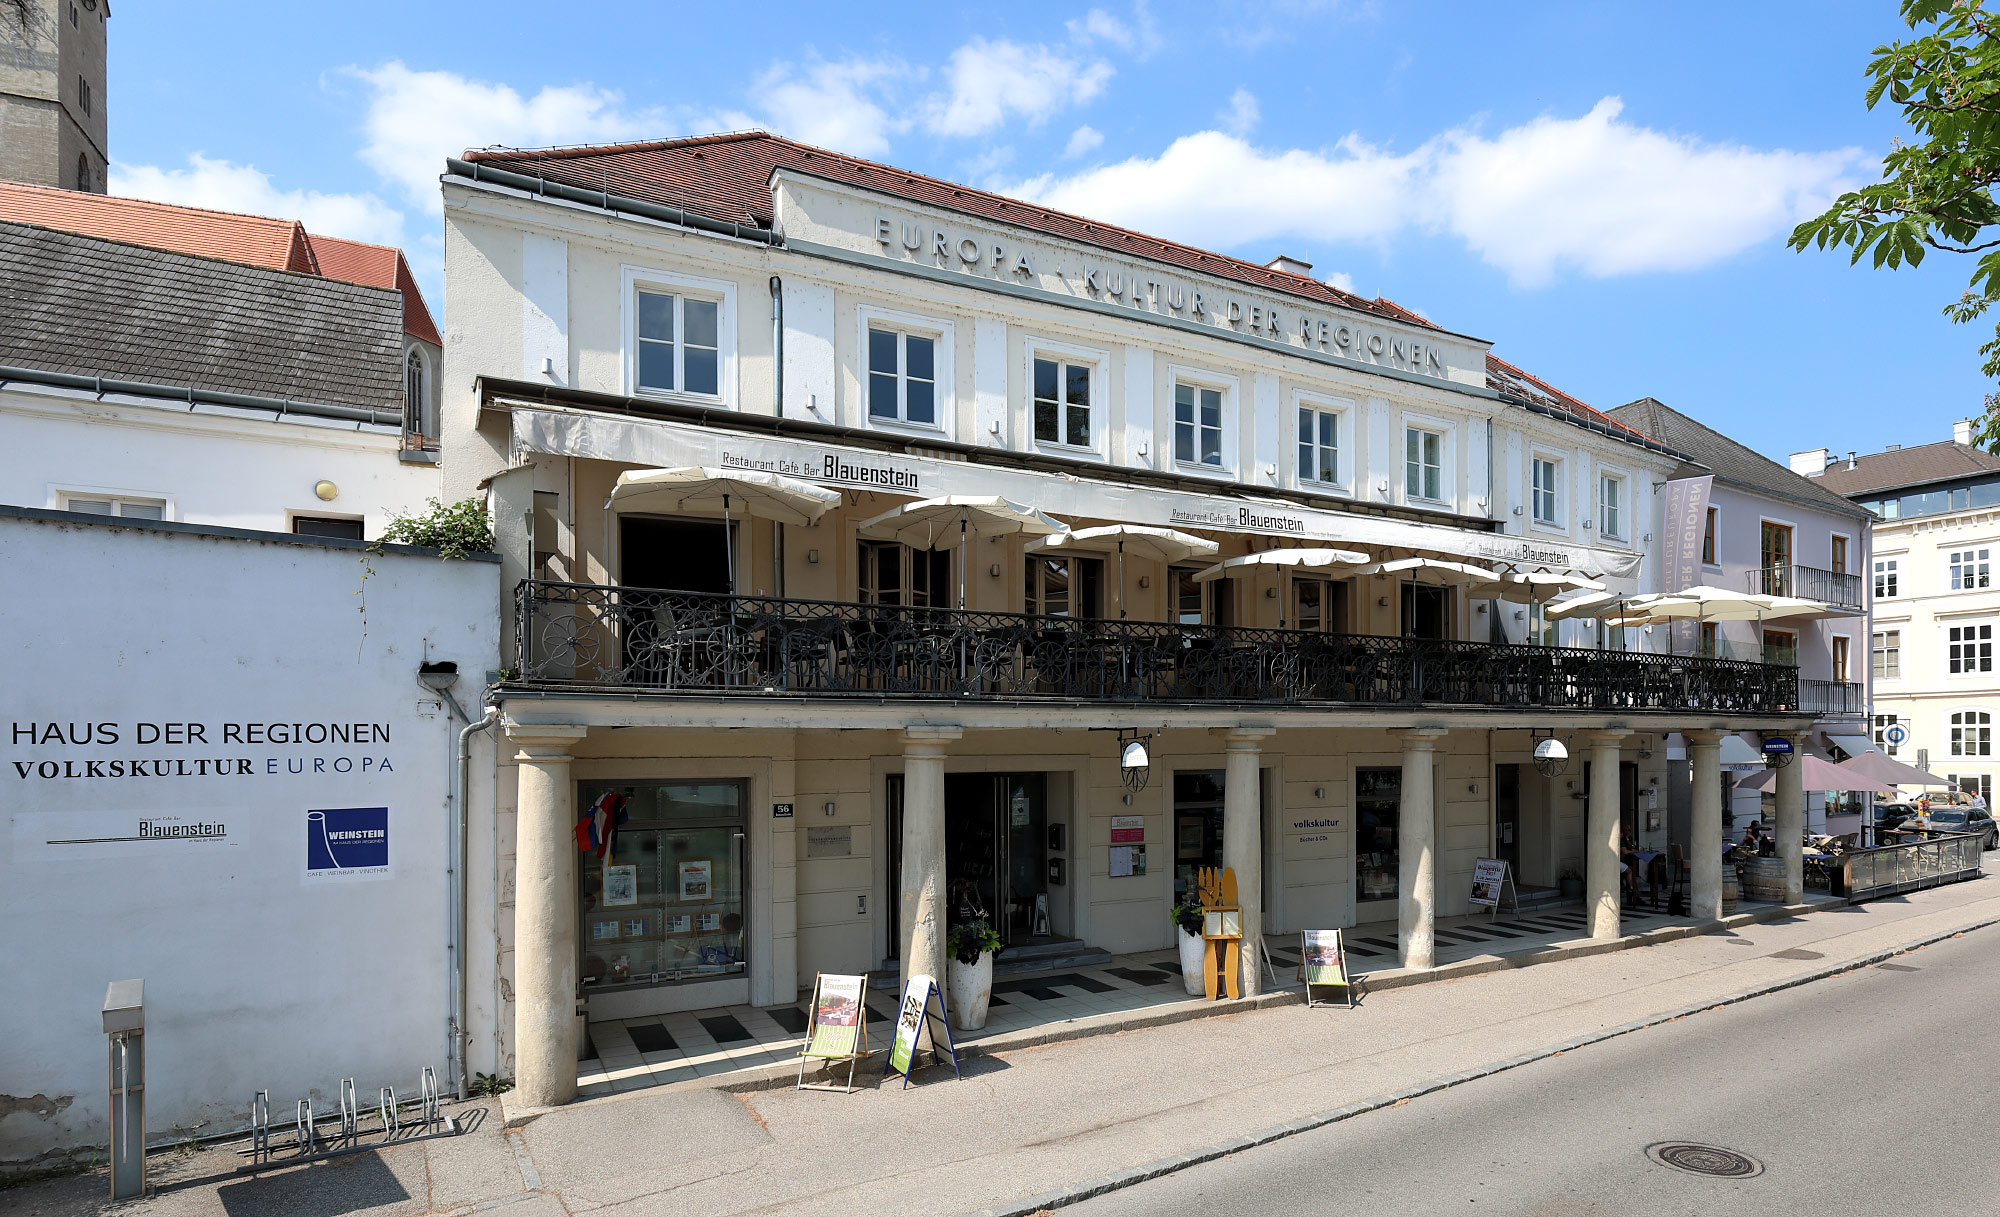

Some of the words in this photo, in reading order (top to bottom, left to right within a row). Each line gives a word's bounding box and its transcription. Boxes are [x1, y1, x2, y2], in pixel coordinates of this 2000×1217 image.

[875, 215, 1033, 276] EUROPA
[1084, 264, 1204, 315] KULTUR
[1227, 299, 1280, 332] DER
[1300, 315, 1441, 368] REGIONEN
[804, 463, 820, 476] Bar
[824, 454, 918, 488] Blauenstein
[1239, 507, 1304, 532] Blauenstein
[1522, 544, 1569, 564] Blauenstein
[12, 722, 120, 745] HAUS
[136, 722, 209, 745] DER
[223, 723, 390, 744] REGIONEN
[12, 758, 255, 779] VOLKSKULTUR
[266, 757, 394, 774] EUROPA
[777, 804, 790, 813] 56
[139, 821, 226, 837] Blauenstein
[1294, 819, 1339, 828] volkskultur
[329, 830, 384, 839] WEINSTEIN
[359, 867, 388, 875] VINOTHEK
